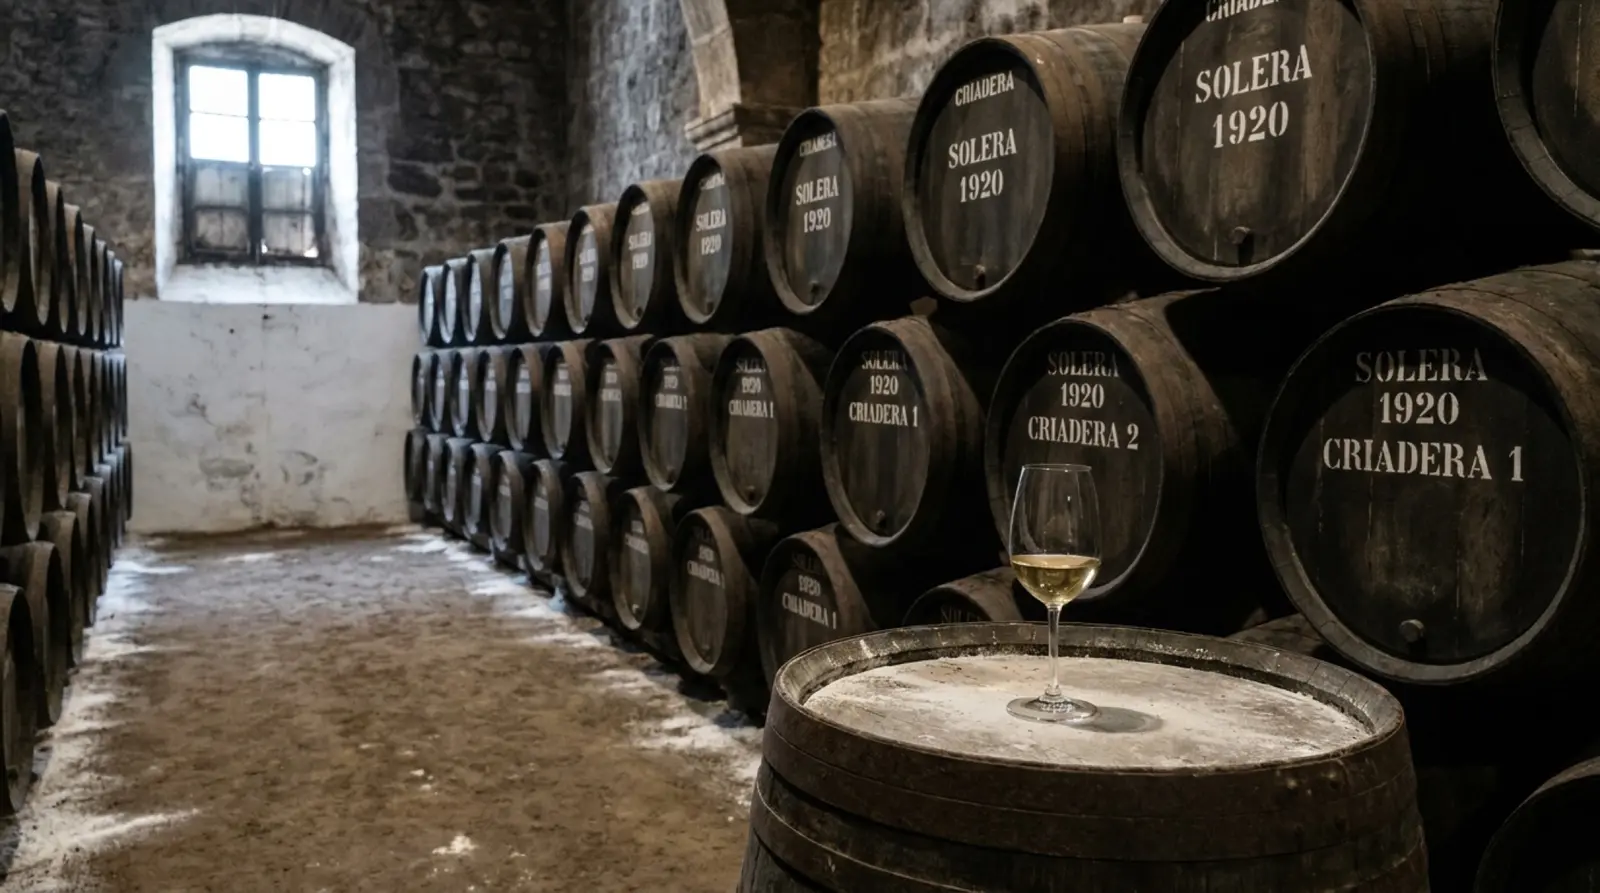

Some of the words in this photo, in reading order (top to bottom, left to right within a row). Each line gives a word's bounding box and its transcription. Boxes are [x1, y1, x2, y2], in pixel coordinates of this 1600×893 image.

[1206, 0, 1279, 22] CRIA
[955, 70, 1014, 106] CRIADERA
[1195, 44, 1312, 103] SOLERA
[1213, 101, 1289, 148] 1920
[948, 128, 1017, 168] SOLERA
[795, 175, 839, 206] SOLERA
[960, 168, 1004, 203] 1920
[803, 207, 831, 233] 1920
[1047, 350, 1119, 378] SOLERA
[1355, 348, 1488, 383] SOLERA
[870, 374, 899, 395] 1920
[1061, 382, 1105, 408] 1920
[849, 401, 908, 426] CRIADERA
[912, 405, 918, 428] 1
[1379, 392, 1460, 425] 1920
[1028, 416, 1120, 449] CRIADERA
[1126, 423, 1139, 450] 2
[1323, 437, 1492, 480] CRIADERA
[1508, 445, 1524, 482] 1
